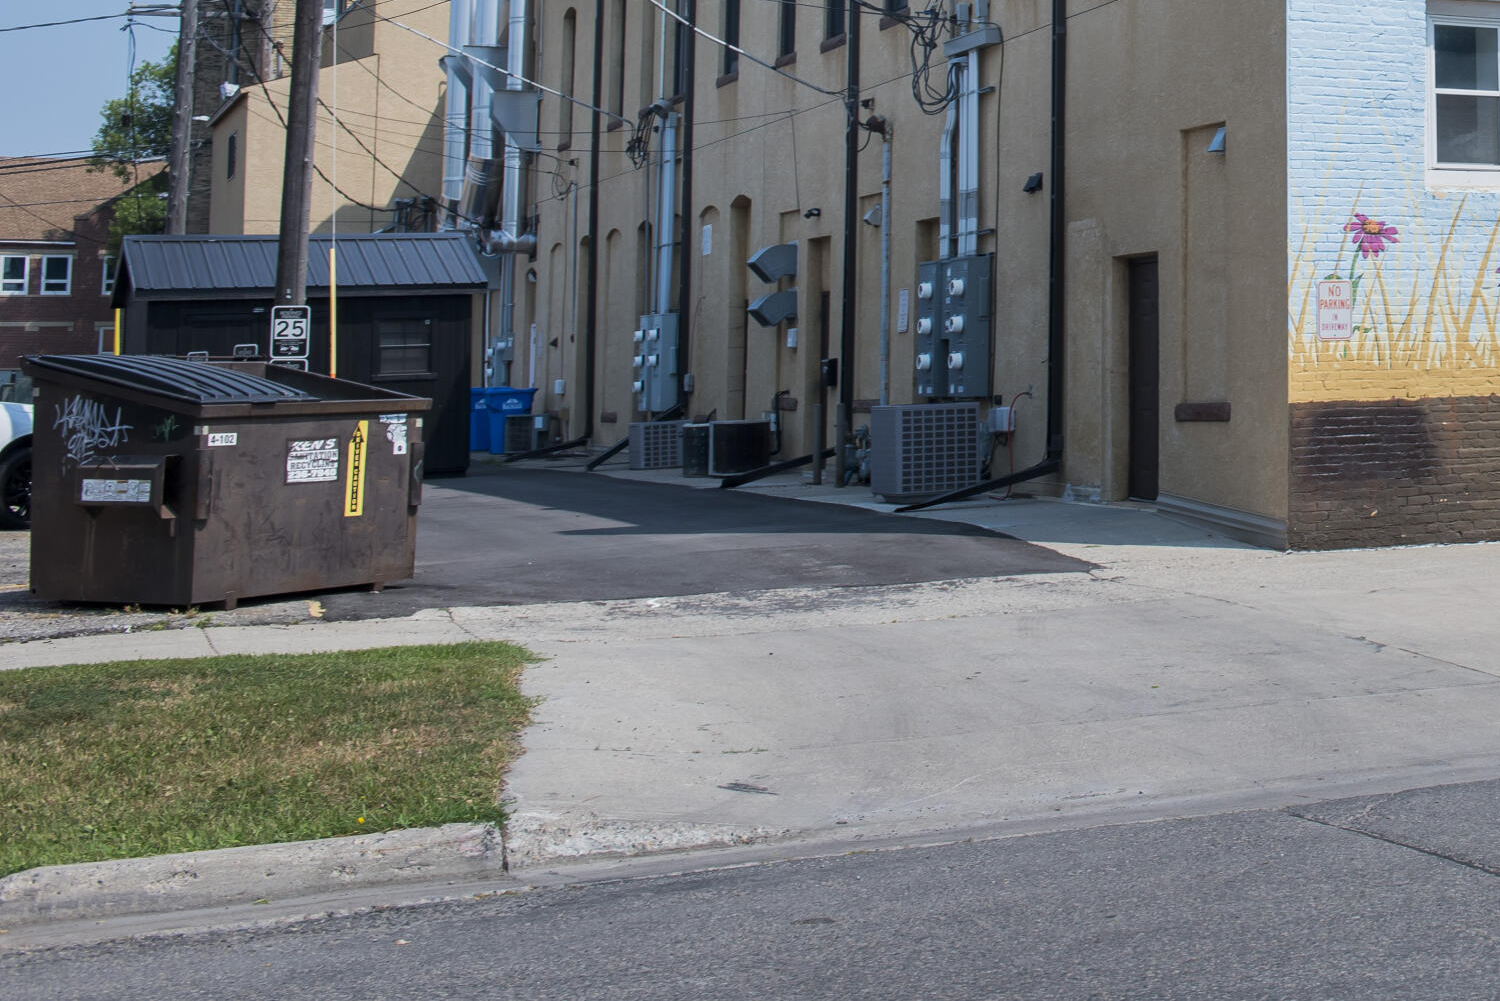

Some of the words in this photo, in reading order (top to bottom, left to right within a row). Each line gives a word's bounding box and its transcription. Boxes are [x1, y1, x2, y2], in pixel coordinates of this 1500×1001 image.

[1328, 286, 1341, 297] NO
[1320, 299, 1350, 309] PARKING
[276, 320, 305, 338] 25
[210, 434, 235, 444] 4-102
